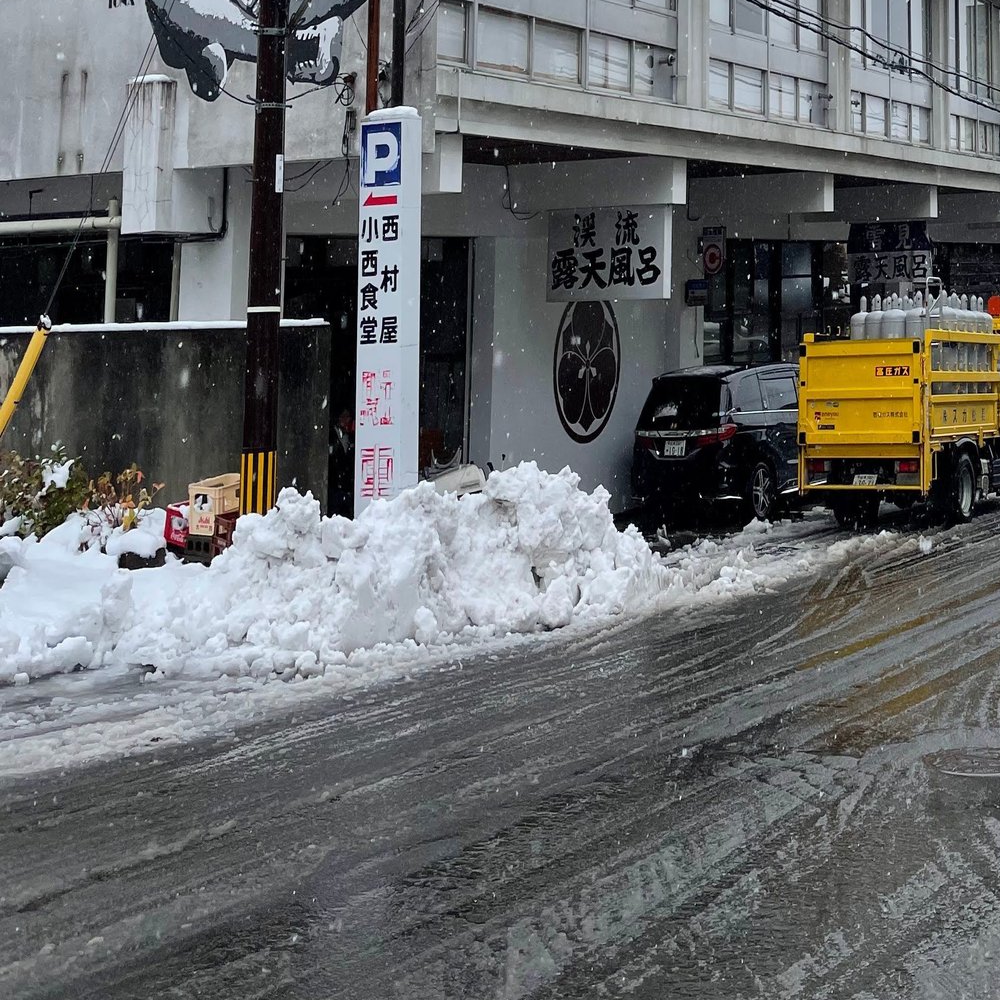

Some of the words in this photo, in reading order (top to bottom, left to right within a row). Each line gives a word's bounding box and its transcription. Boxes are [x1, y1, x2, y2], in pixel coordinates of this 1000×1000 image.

[366, 131, 399, 184] P
[360, 216, 379, 345] 小西食堂
[380, 214, 400, 344] 西村屋
[551, 246, 661, 290] 露天風呂
[854, 253, 929, 281] 露天風呂
